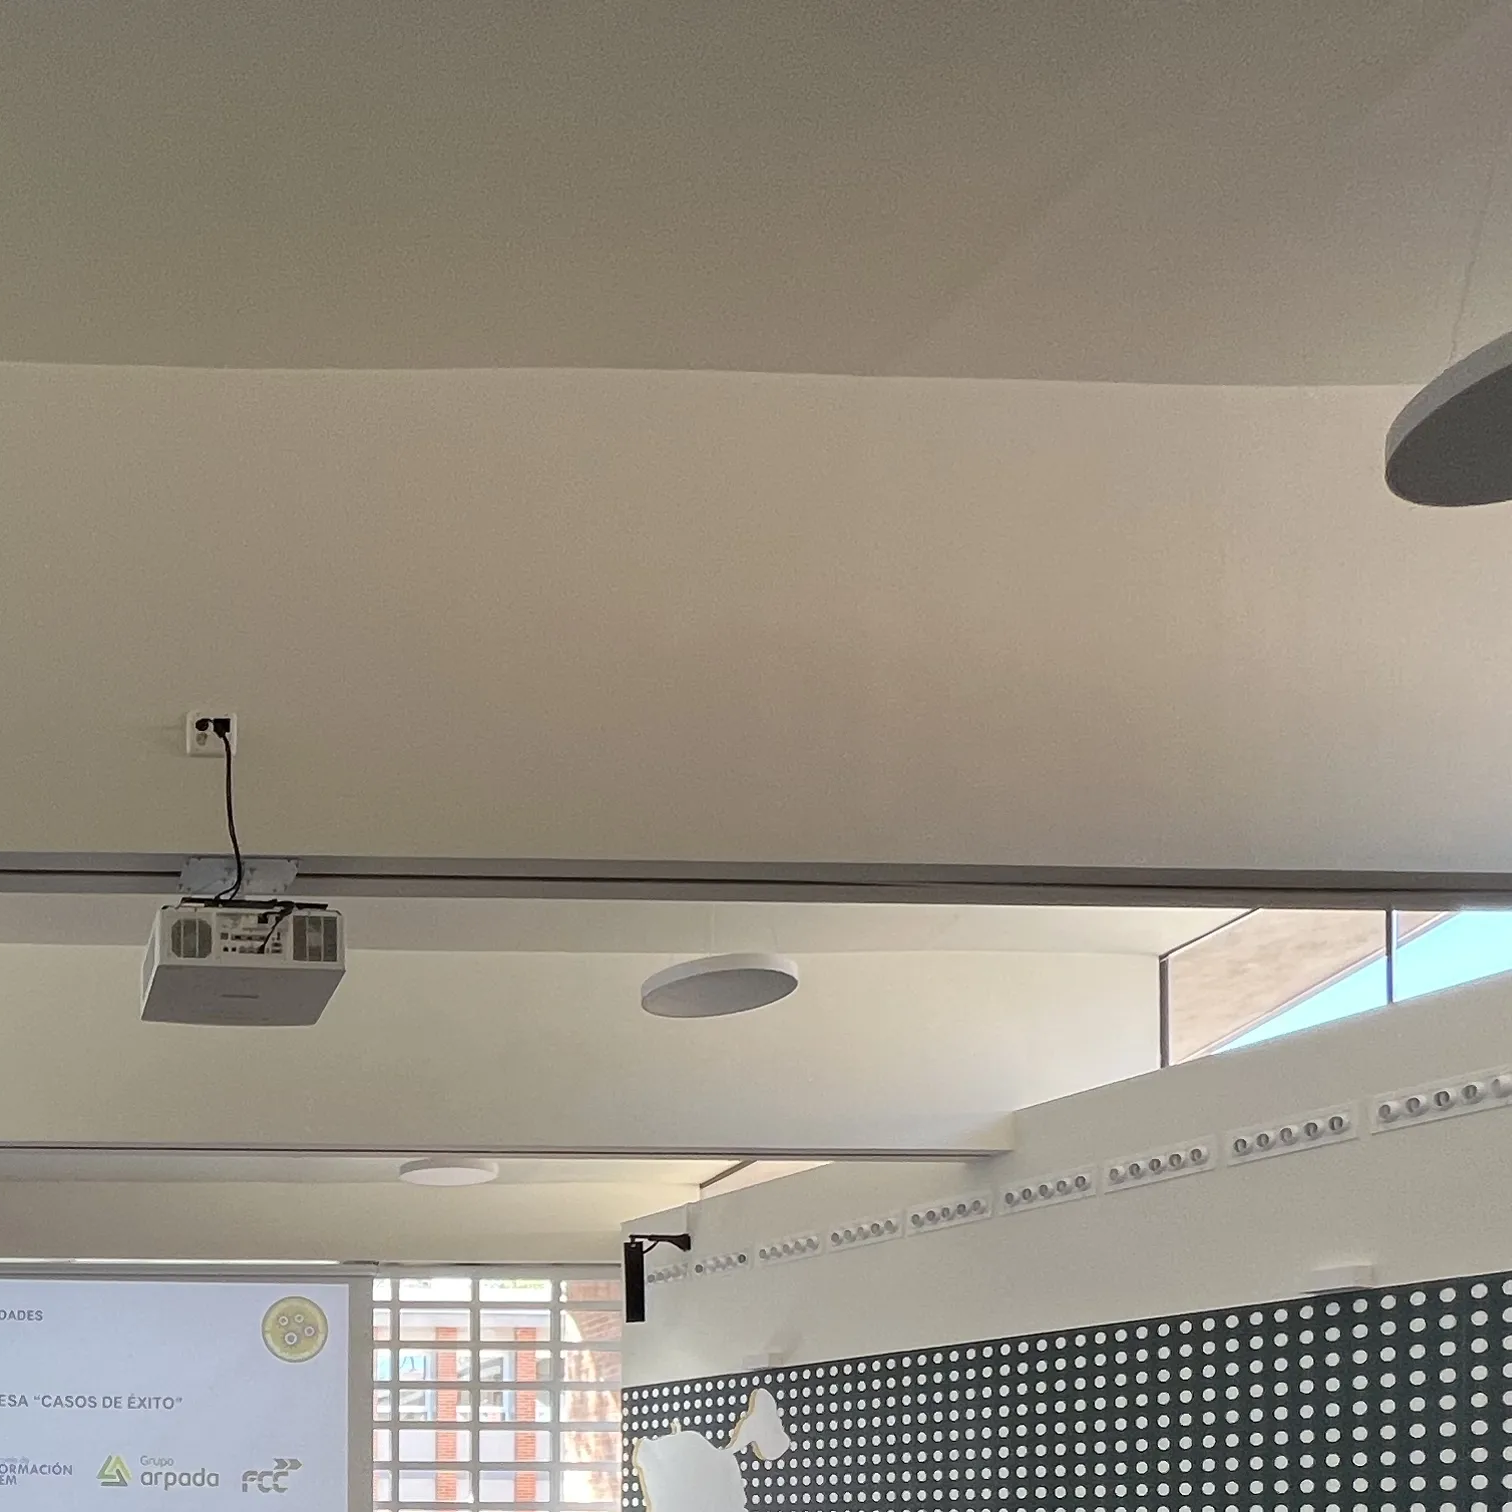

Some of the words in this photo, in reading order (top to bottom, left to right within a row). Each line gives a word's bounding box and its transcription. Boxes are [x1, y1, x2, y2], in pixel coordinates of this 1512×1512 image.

[34, 1394, 97, 1409] “CASOS
[102, 1396, 122, 1409] DE
[127, 1393, 182, 1410] ÉXITO”
[140, 1455, 174, 1467] Grupo
[140, 1468, 219, 1490] arpada
